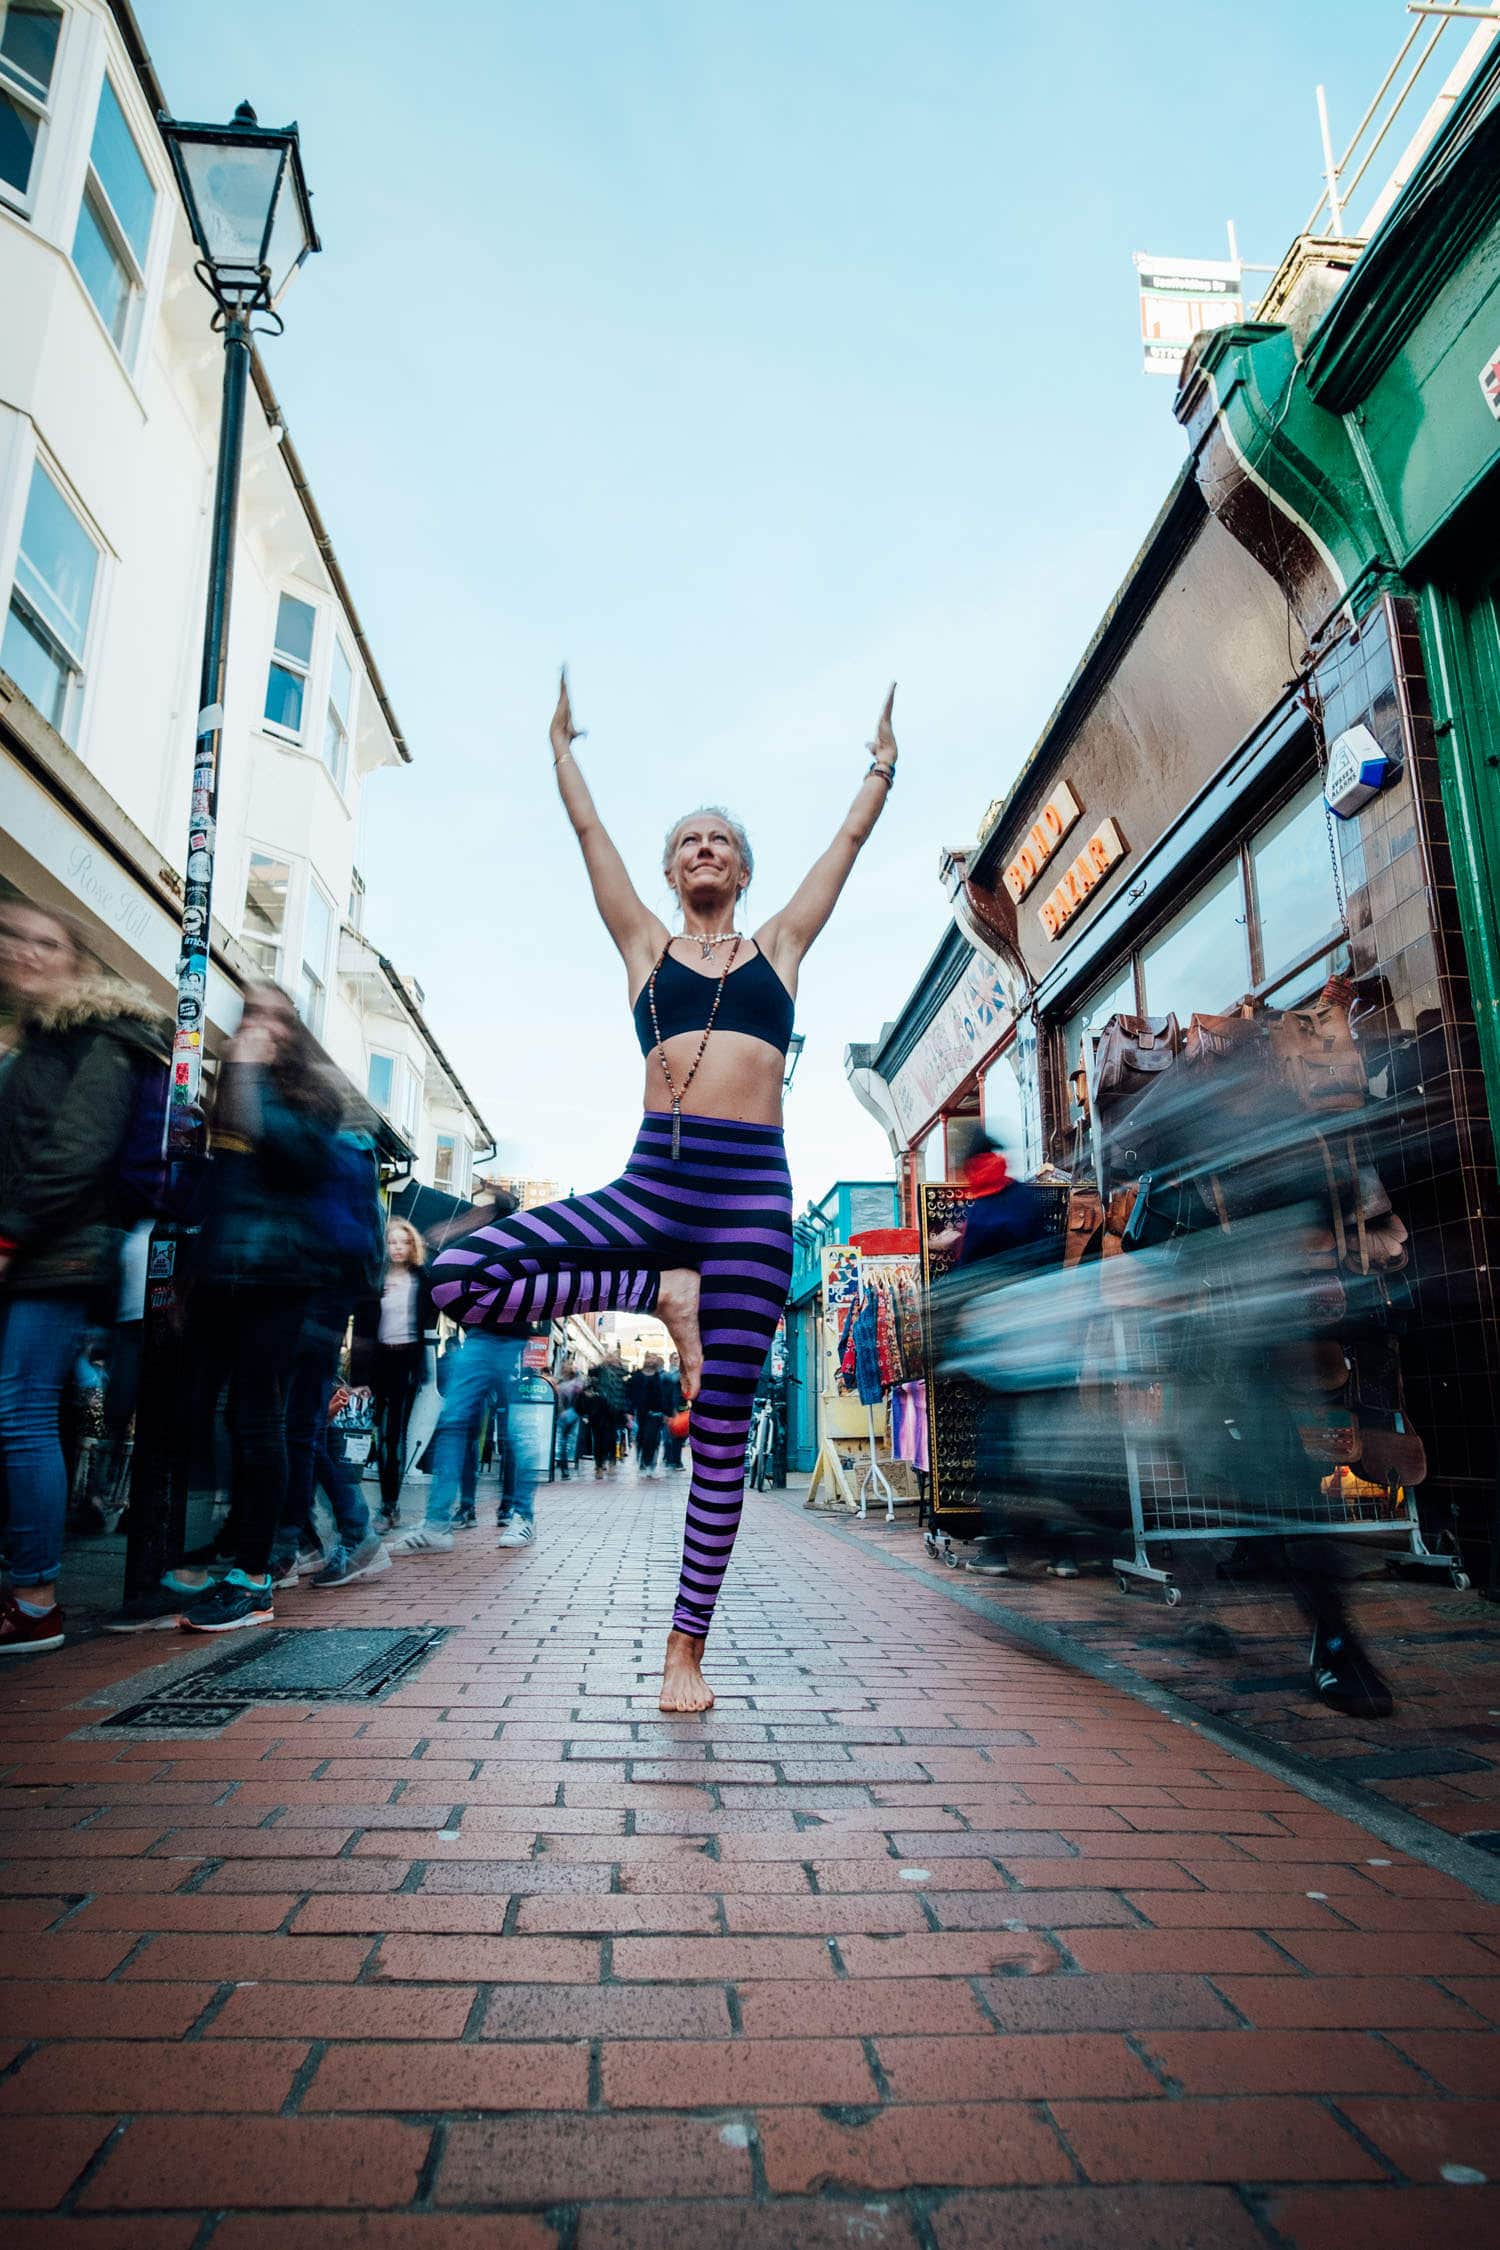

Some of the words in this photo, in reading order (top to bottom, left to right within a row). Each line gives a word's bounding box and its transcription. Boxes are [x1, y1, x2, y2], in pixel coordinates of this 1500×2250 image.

[68, 847, 113, 909] Rose
[114, 891, 152, 940] Hill
[1008, 803, 1063, 895] BOHO
[1042, 837, 1112, 936] BAZAR
